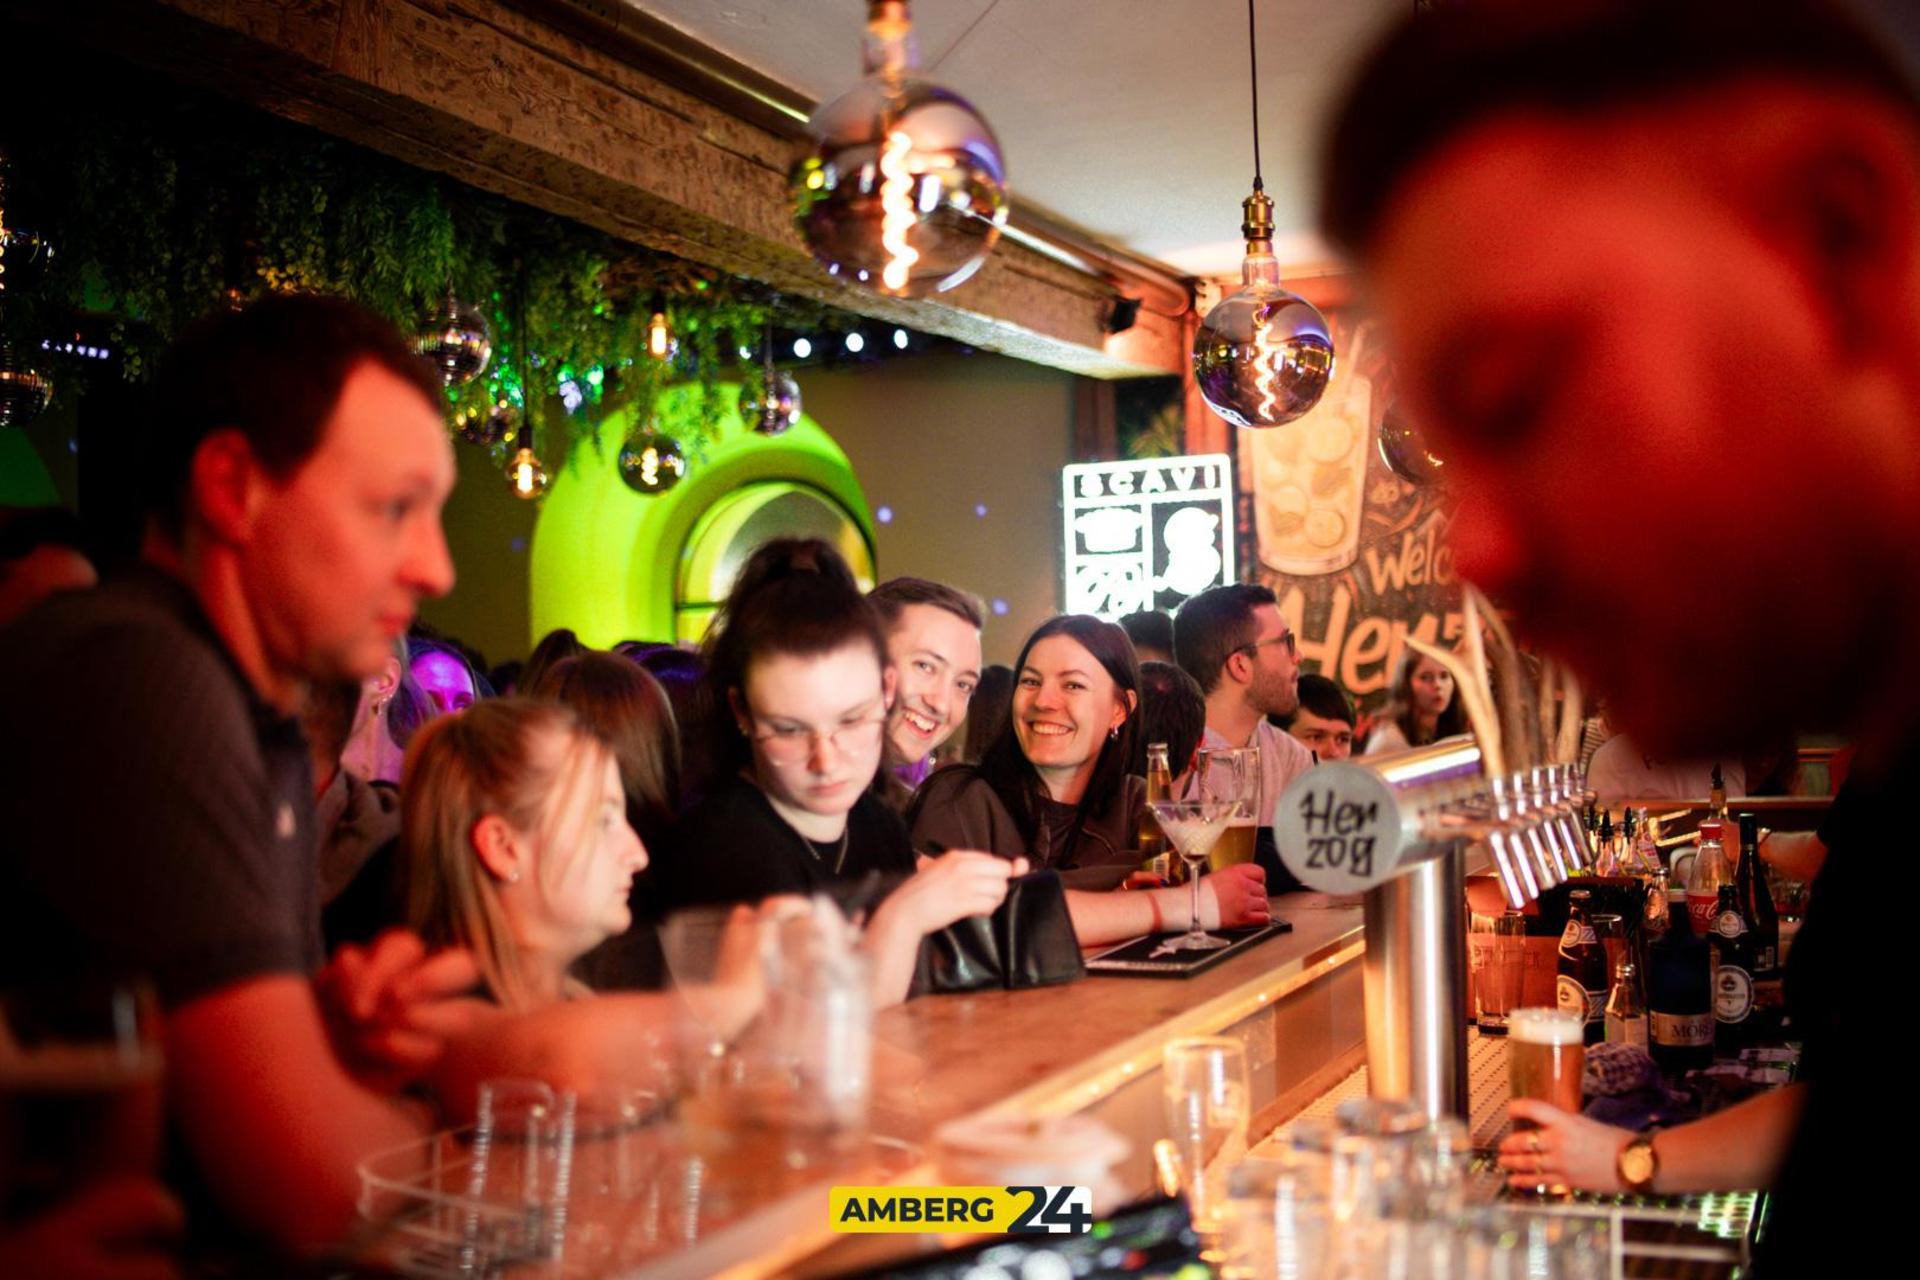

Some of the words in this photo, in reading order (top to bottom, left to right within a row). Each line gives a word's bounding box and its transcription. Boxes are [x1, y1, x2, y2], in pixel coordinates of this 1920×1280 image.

[1080, 464, 1217, 497] SCAVI
[1365, 528, 1454, 596] Welc
[1298, 789, 1379, 835] Her
[1305, 836, 1377, 877] zog
